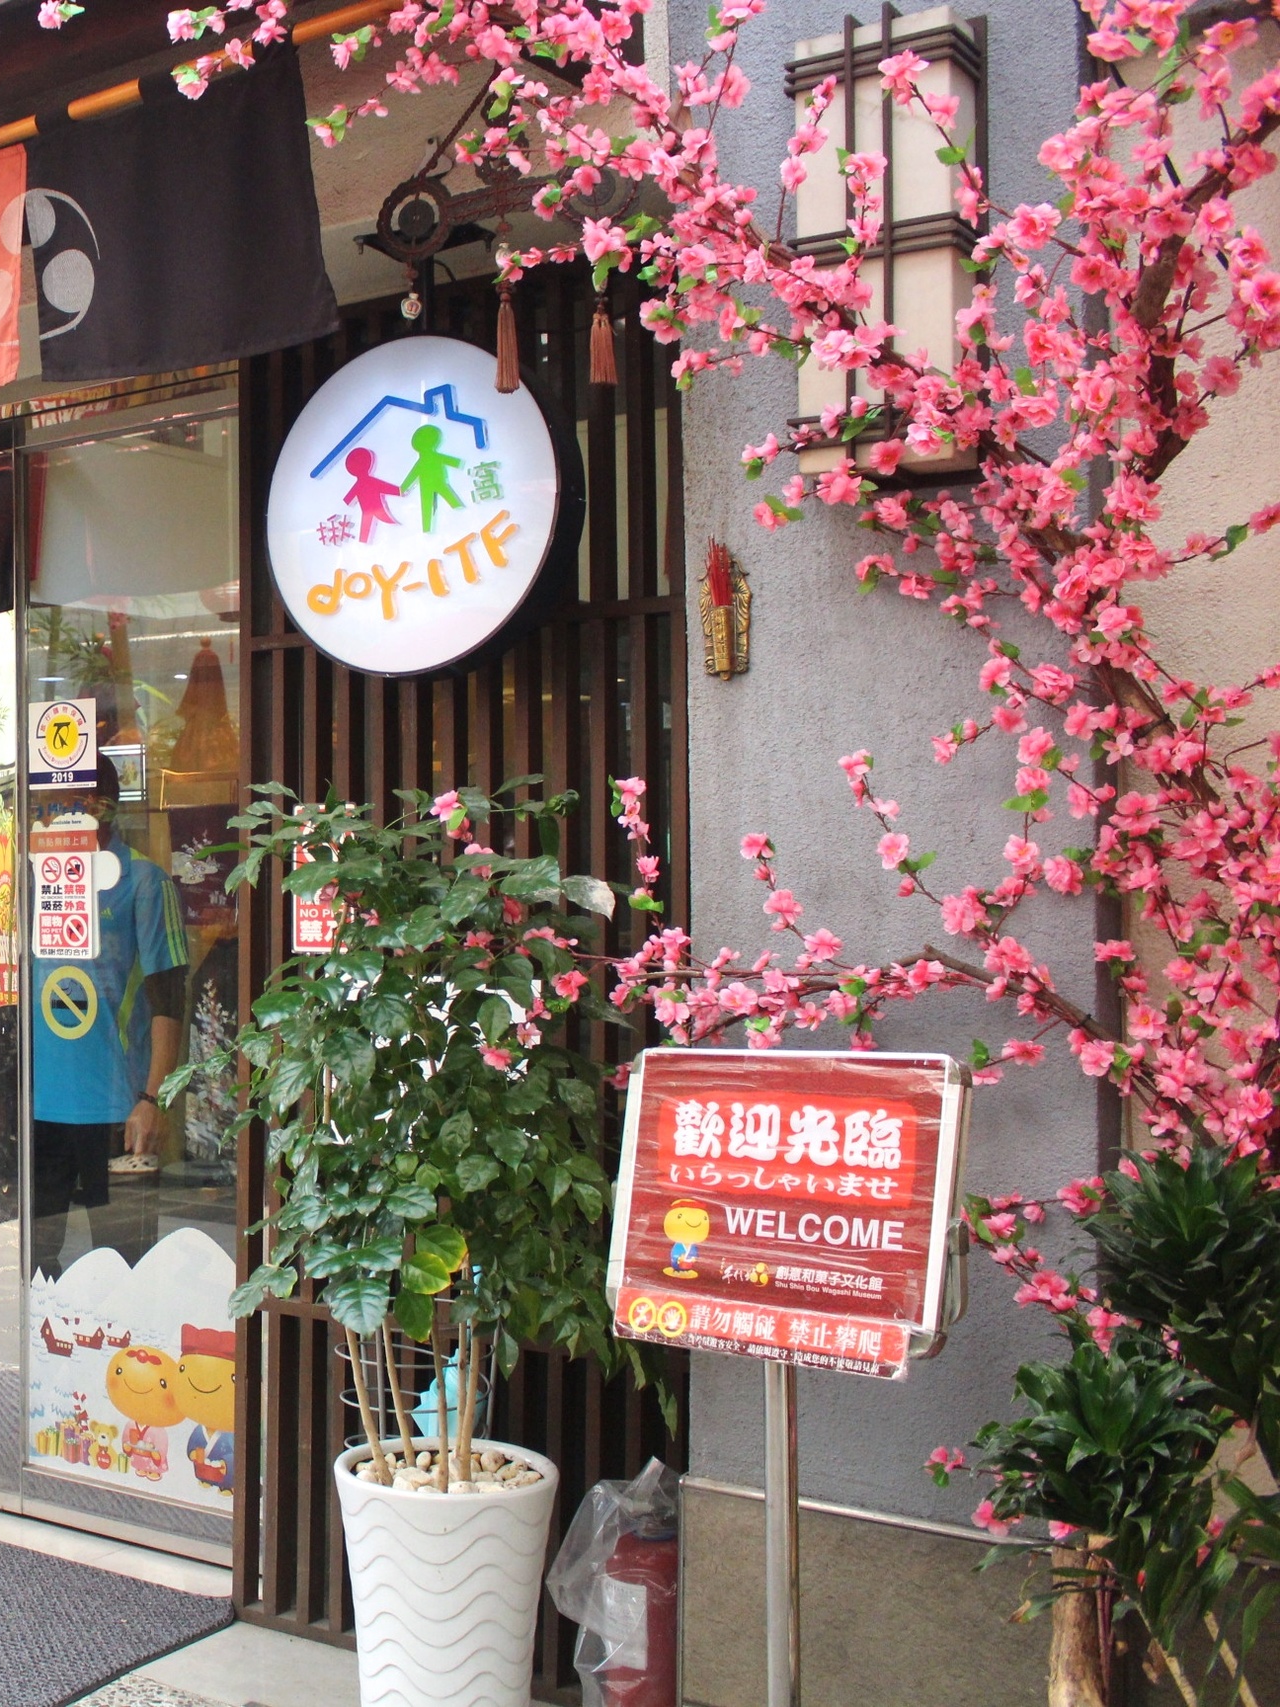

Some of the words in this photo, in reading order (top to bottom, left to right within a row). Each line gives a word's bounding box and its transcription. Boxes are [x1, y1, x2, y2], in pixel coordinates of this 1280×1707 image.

[51, 771, 74, 783] 2019
[41, 884, 63, 895] 禁止
[64, 884, 86, 895] 禁帶
[64, 900, 86, 911] 外食
[300, 908, 319, 918] NO
[41, 934, 63, 946] 禁入
[673, 1099, 904, 1170] 歡迎光臨
[670, 1163, 899, 1200] いらっしゃいませ
[724, 1206, 905, 1251] WELCOME
[775, 1265, 883, 1292] 創意和菓子文化館
[775, 1280, 788, 1288] Shu
[789, 1281, 805, 1290] Shin
[806, 1284, 820, 1293] Bou
[822, 1286, 851, 1298] Wagashi
[852, 1289, 882, 1300] Museum
[690, 1303, 777, 1342] 請勿觸碰
[787, 1318, 882, 1357] 禁止攀爬
